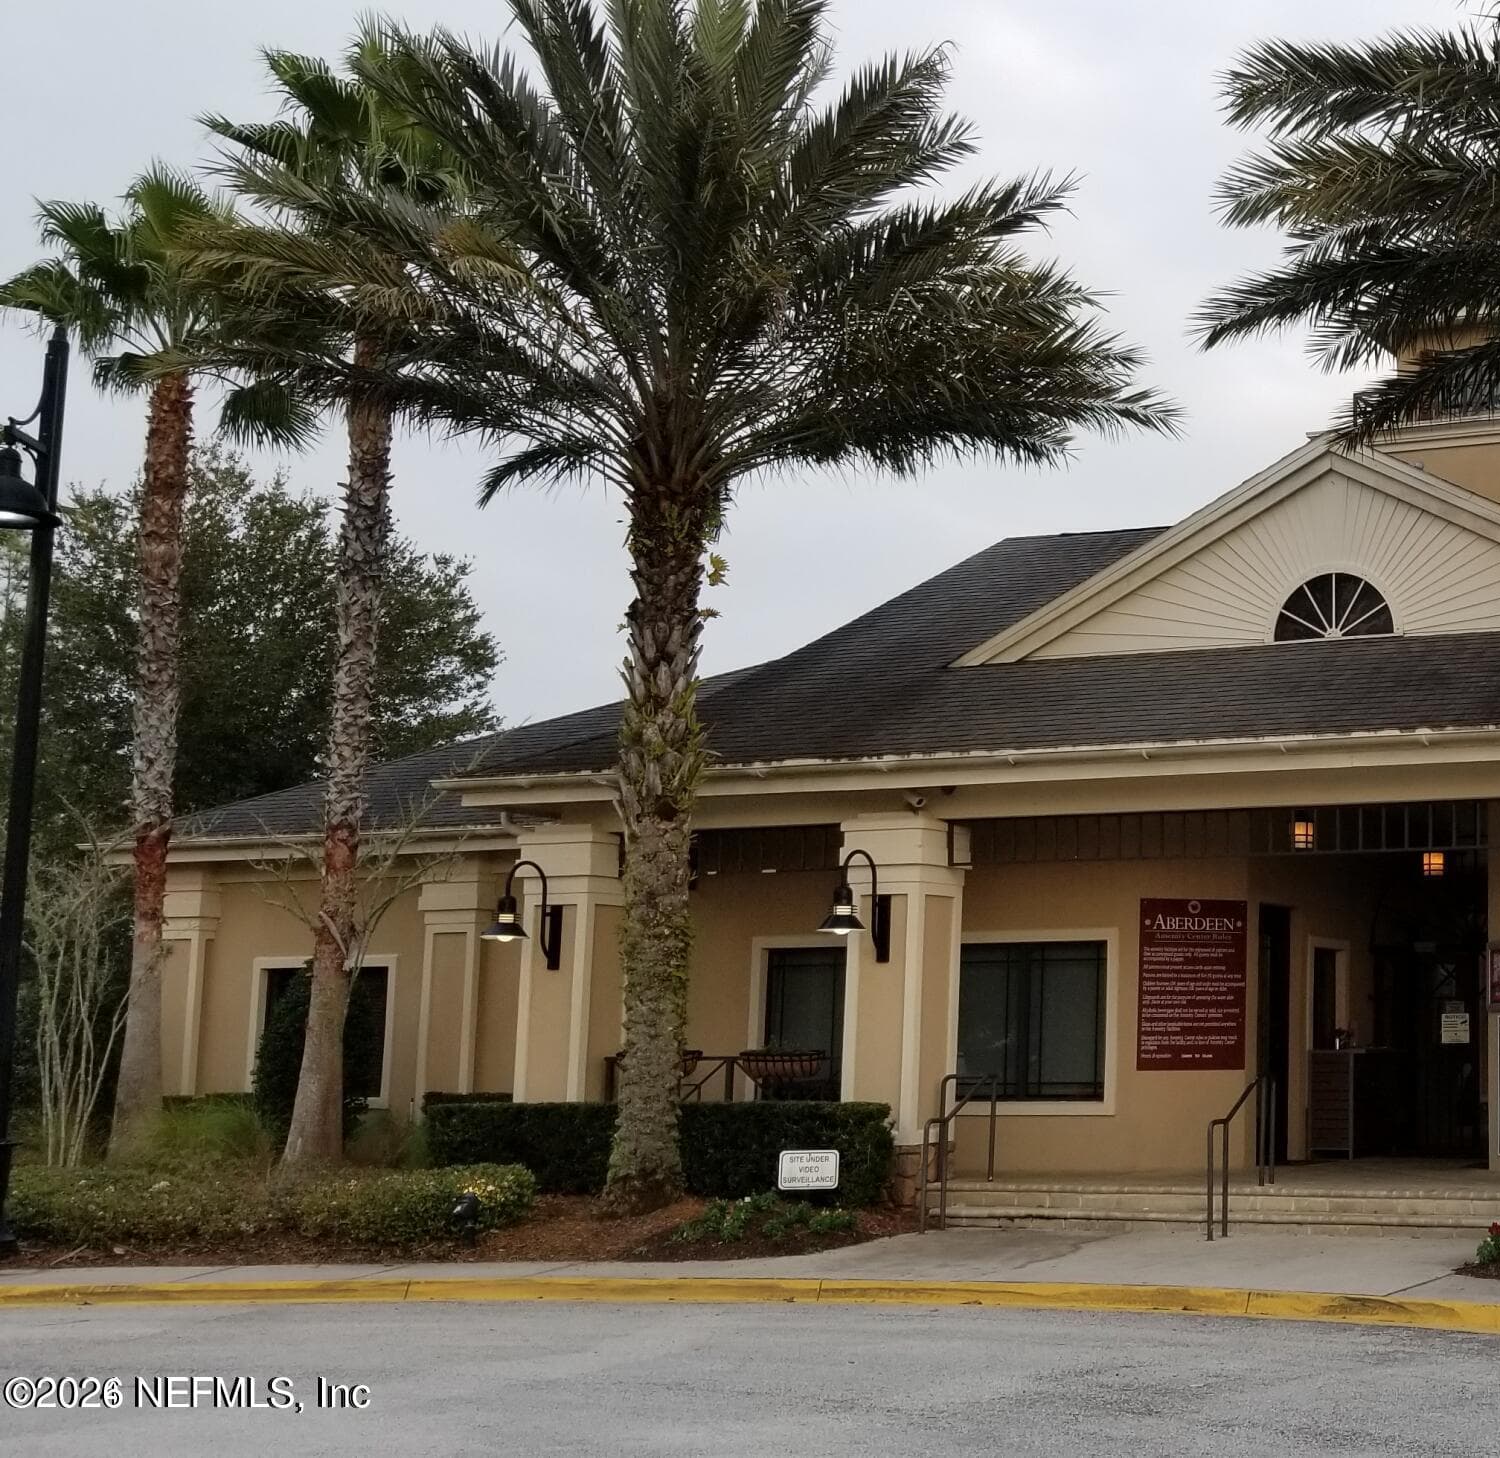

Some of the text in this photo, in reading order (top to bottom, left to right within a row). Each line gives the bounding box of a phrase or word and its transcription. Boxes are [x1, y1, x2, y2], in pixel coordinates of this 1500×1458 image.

[1153, 913, 1235, 931] ABERDEEN
[1212, 933, 1232, 941] Rules
[789, 1155, 830, 1163] SITE UNDER
[798, 1165, 820, 1173] VIDEO
[782, 1175, 835, 1184] SURVEILLANCE
